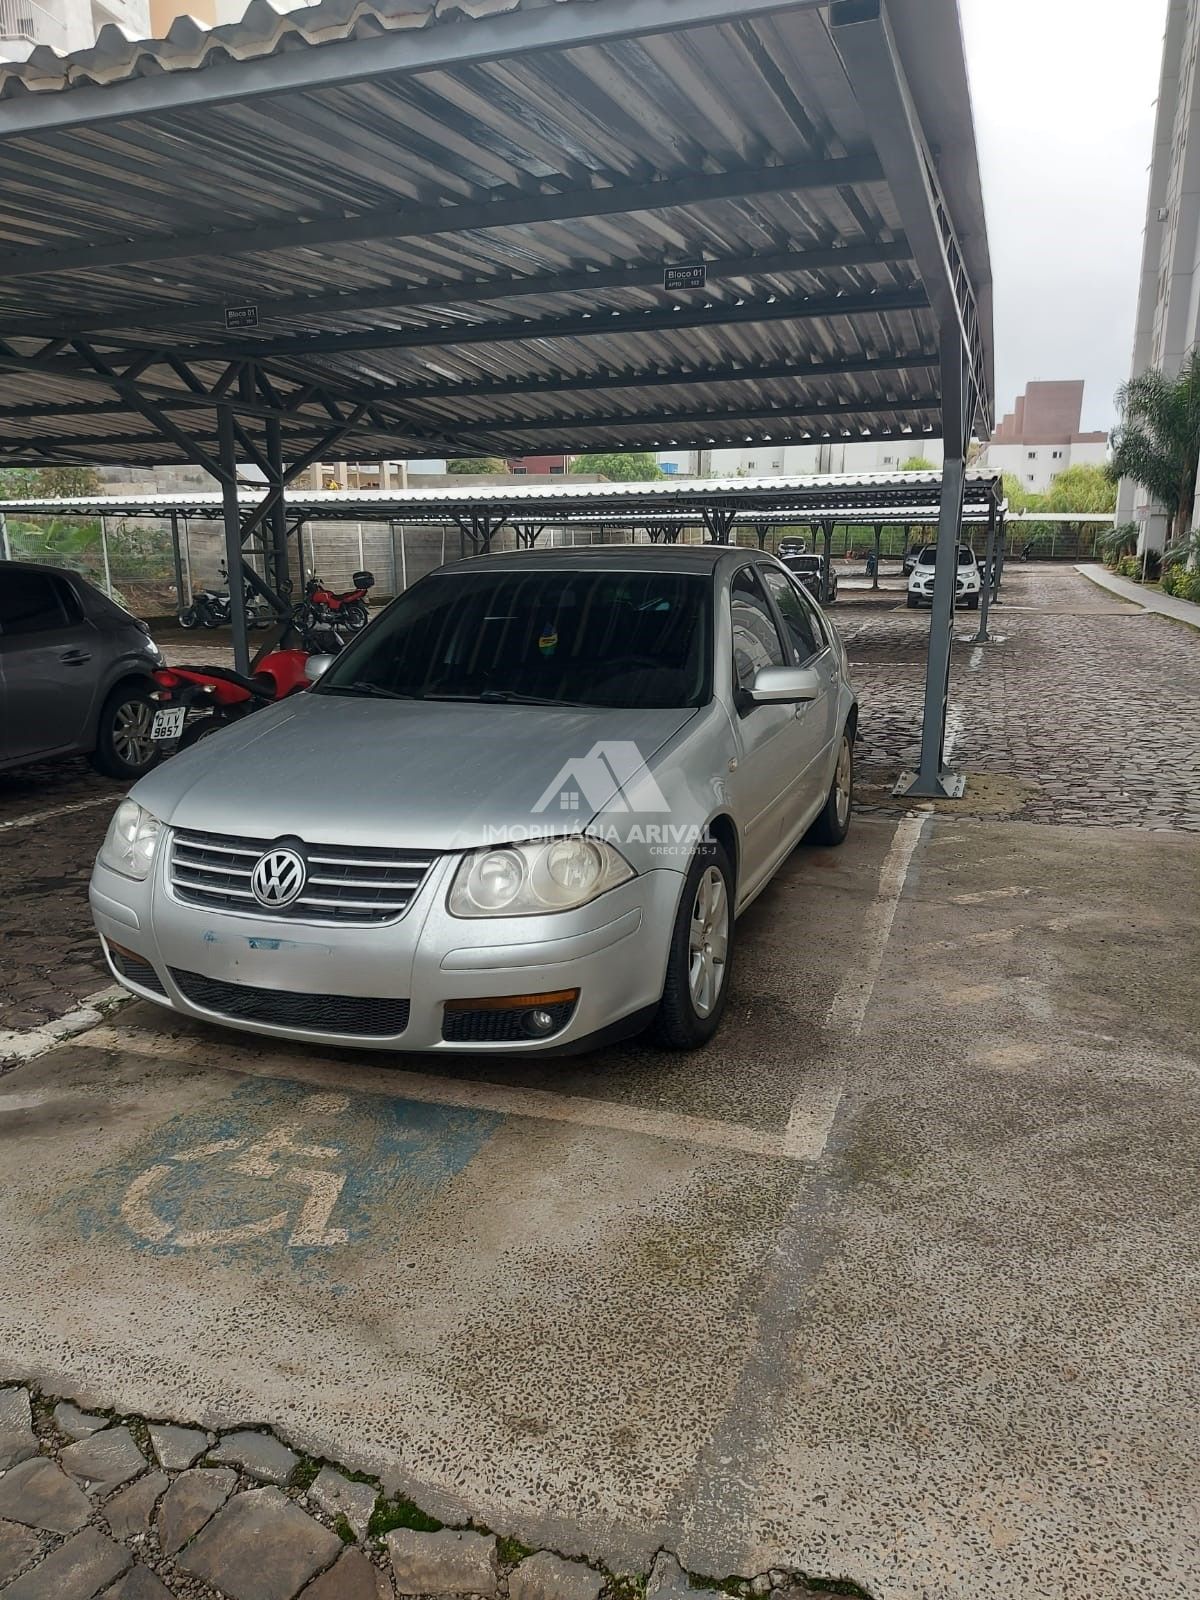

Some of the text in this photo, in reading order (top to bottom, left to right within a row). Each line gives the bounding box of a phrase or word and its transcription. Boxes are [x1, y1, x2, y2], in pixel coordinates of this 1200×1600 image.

[668, 269, 702, 279] Bloco 01
[153, 725, 179, 738] 9857
[253, 850, 304, 906] VW
